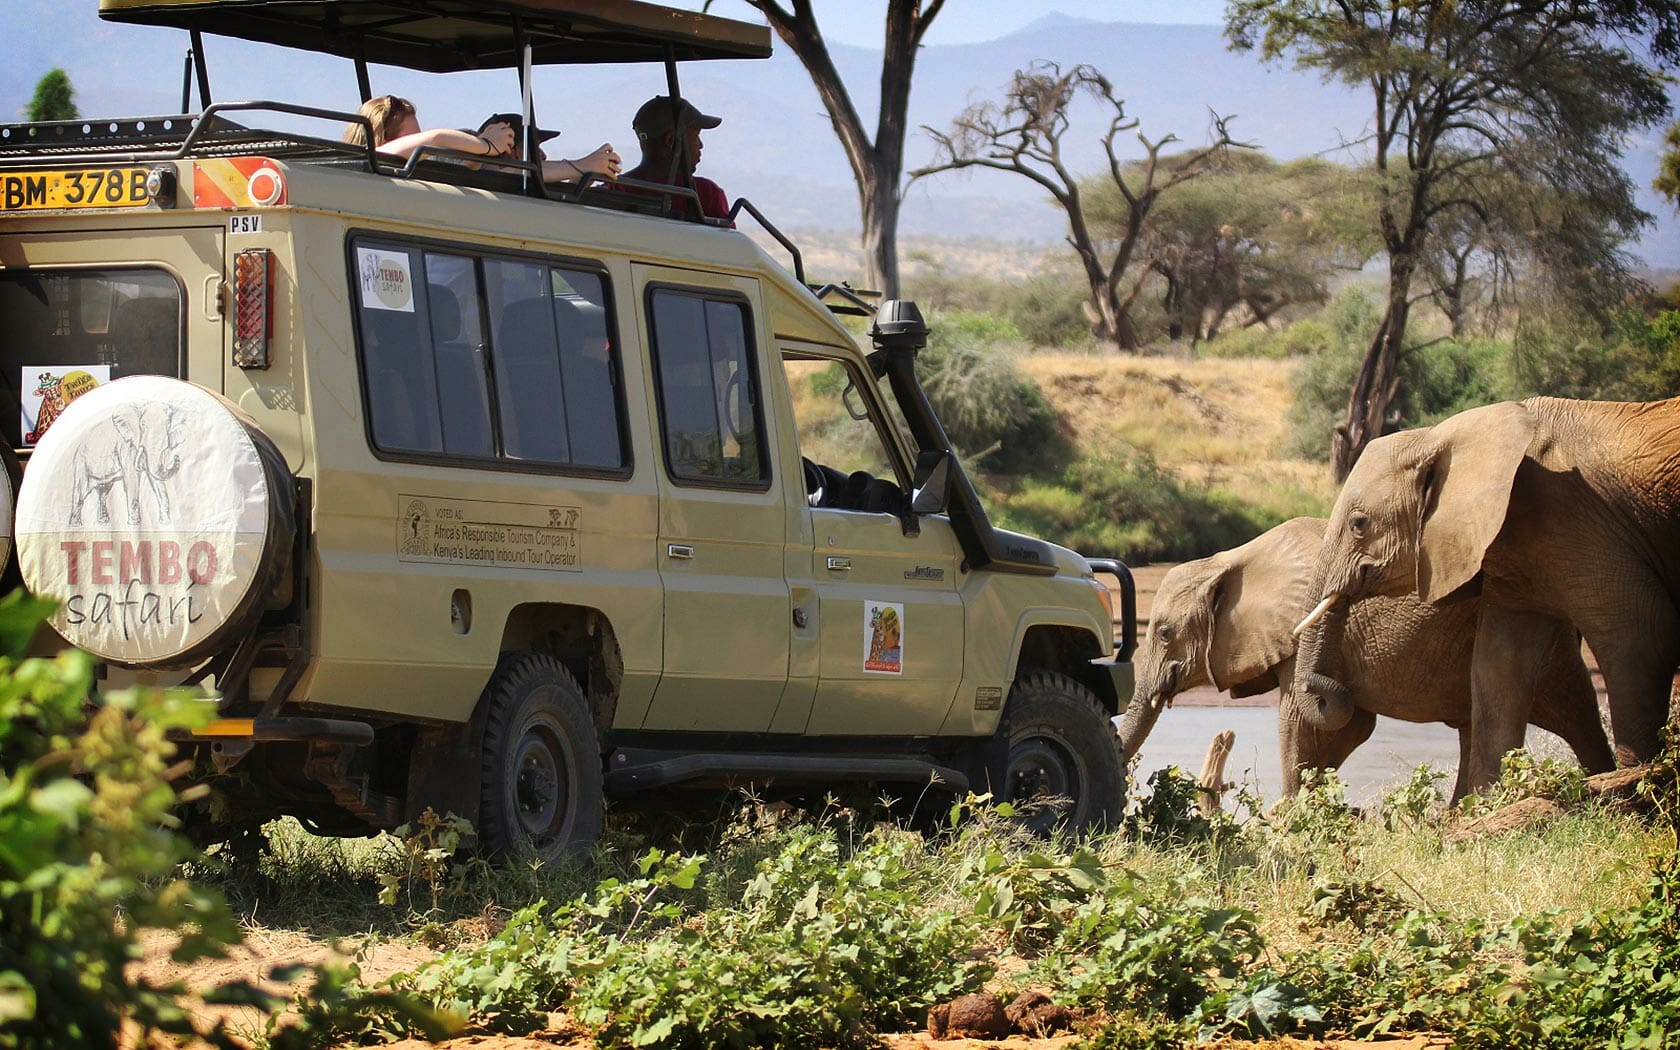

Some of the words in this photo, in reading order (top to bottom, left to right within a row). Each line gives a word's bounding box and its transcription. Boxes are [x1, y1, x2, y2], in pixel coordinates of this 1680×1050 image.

[0, 176, 46, 208] BM
[64, 169, 149, 203] 378B
[231, 216, 259, 233] PSV
[380, 268, 404, 283] TEMBO
[436, 507, 454, 519] VOTED
[434, 523, 461, 541] Africa's
[462, 525, 505, 545] Responsible
[507, 528, 535, 545] Tourism
[535, 529, 569, 551] Company
[569, 532, 576, 548] &
[60, 540, 219, 586] TEMBO
[433, 542, 463, 561] Kenya's
[465, 544, 494, 565] Leading
[496, 546, 526, 563] Inbound
[527, 548, 543, 564] Tour
[544, 549, 577, 568] Operator
[66, 577, 204, 641] safari
